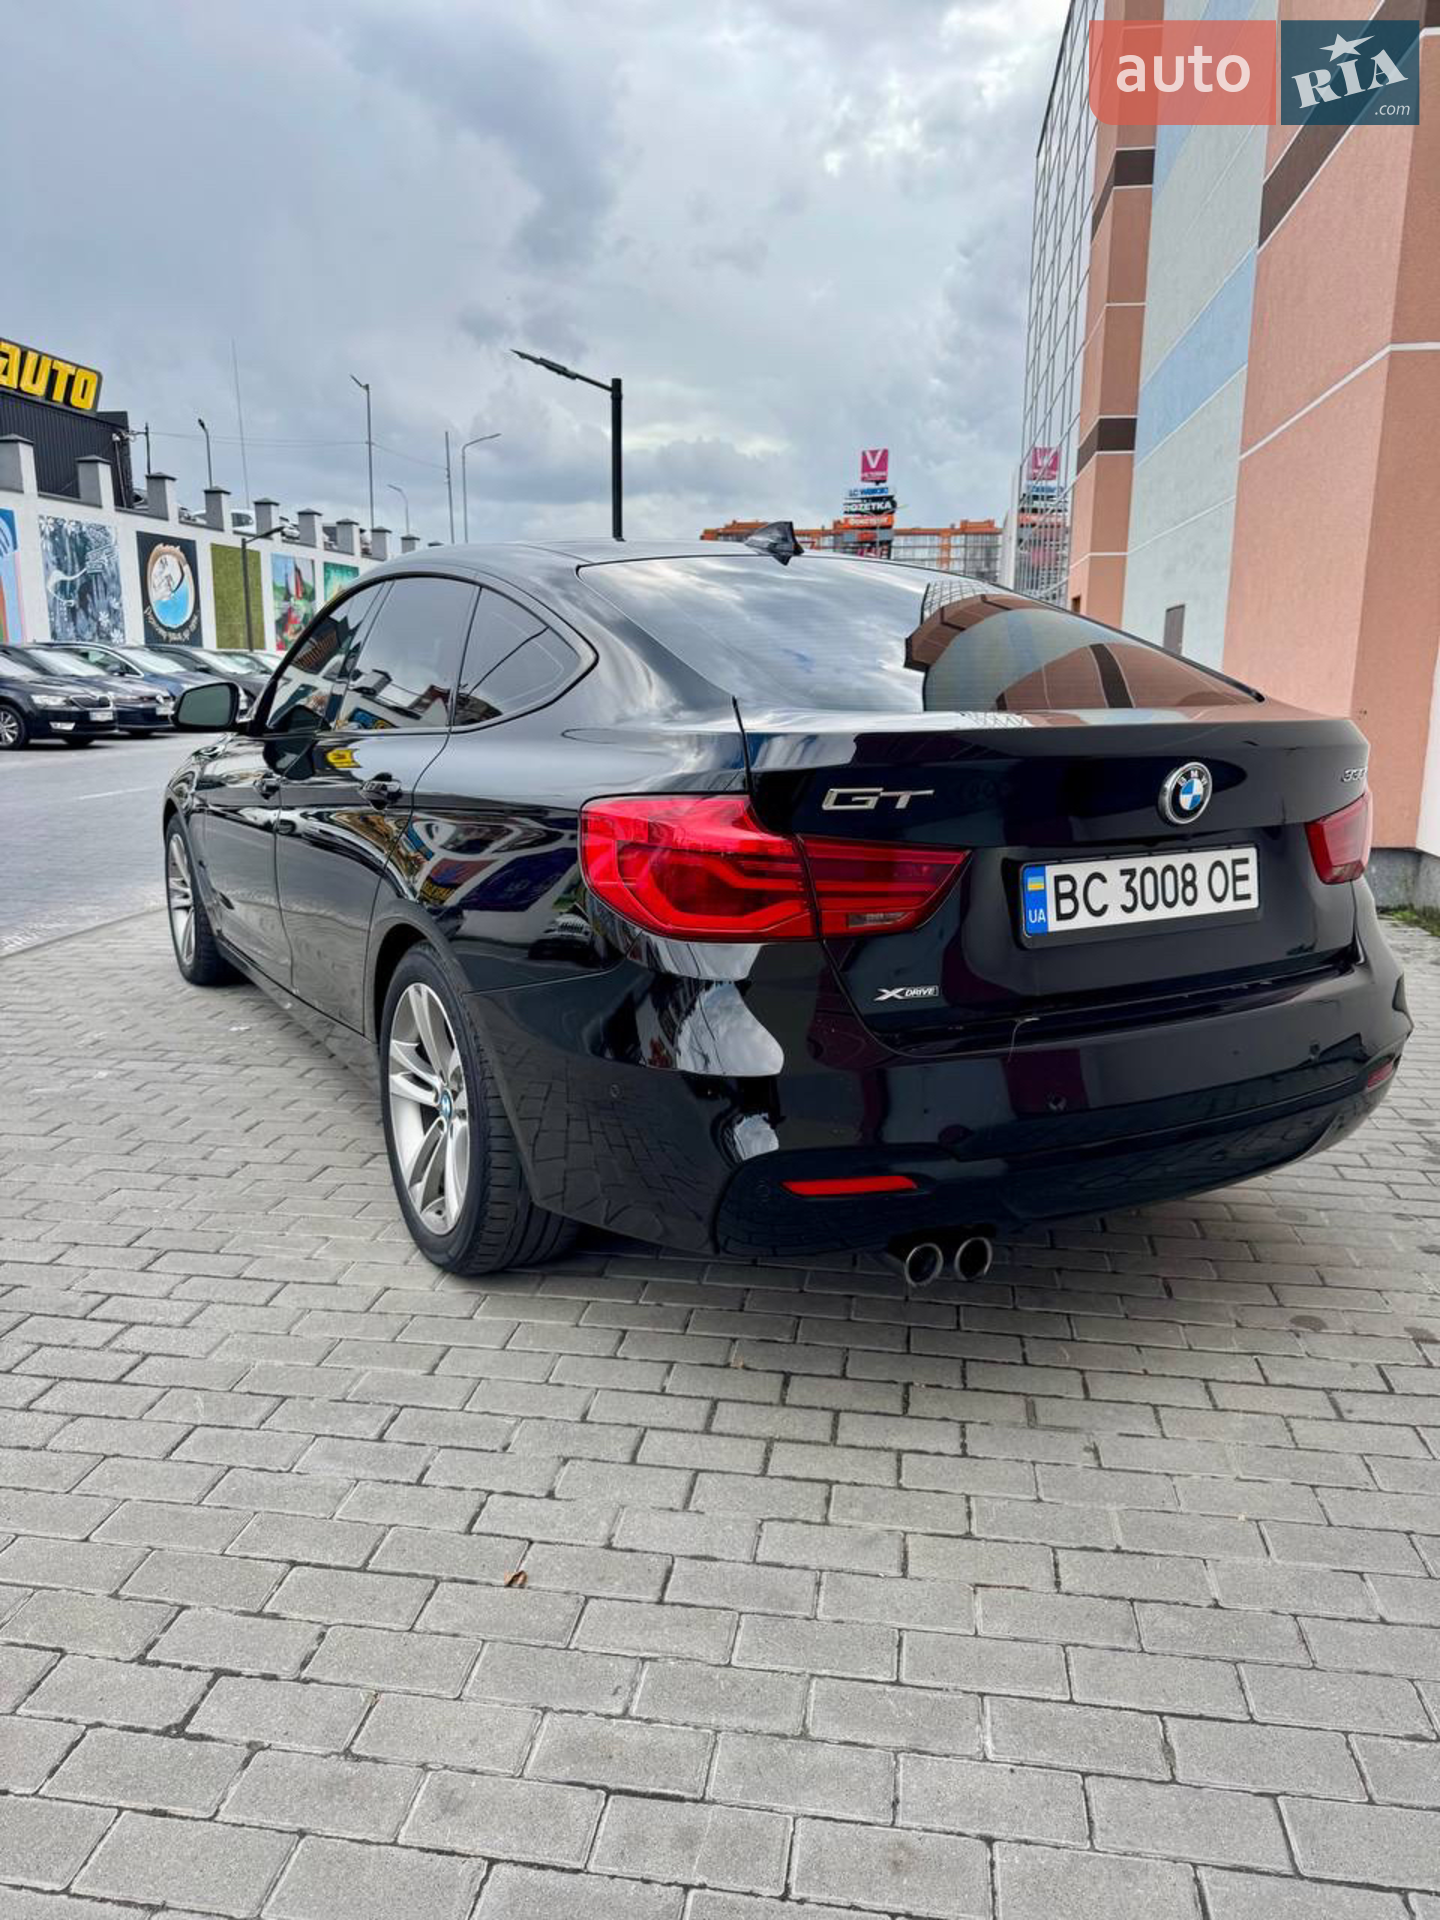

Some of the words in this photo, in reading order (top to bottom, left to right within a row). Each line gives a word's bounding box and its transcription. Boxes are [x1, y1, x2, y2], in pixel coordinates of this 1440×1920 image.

[1176, 769, 1208, 787] BMW
[822, 787, 934, 810] GT
[1053, 872, 1109, 921] BC
[1120, 863, 1198, 914] 3008
[1208, 858, 1252, 903] OE
[1029, 909, 1046, 924] UA
